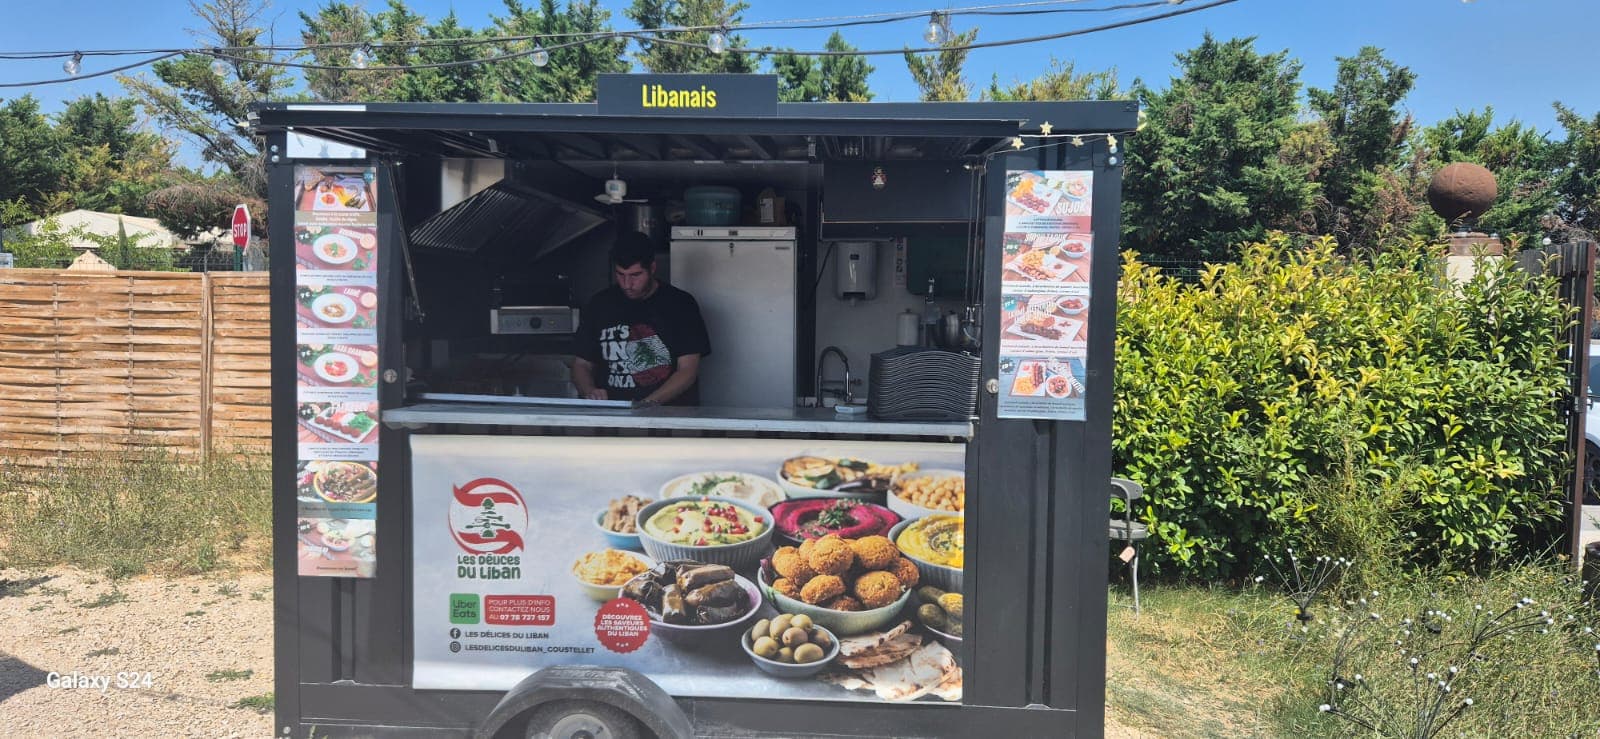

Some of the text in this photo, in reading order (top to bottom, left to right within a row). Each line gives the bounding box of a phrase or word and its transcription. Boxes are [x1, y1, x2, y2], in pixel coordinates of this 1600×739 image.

[642, 84, 717, 108] Libanais
[233, 222, 247, 238] STOP
[600, 324, 629, 340] IT'S
[601, 340, 629, 360] IN
[453, 600, 477, 609] Uber
[453, 608, 477, 618] Eats
[480, 629, 511, 638] DÉLICES
[464, 644, 595, 654] LESDELICESDULIBAN_COUSTELLET
